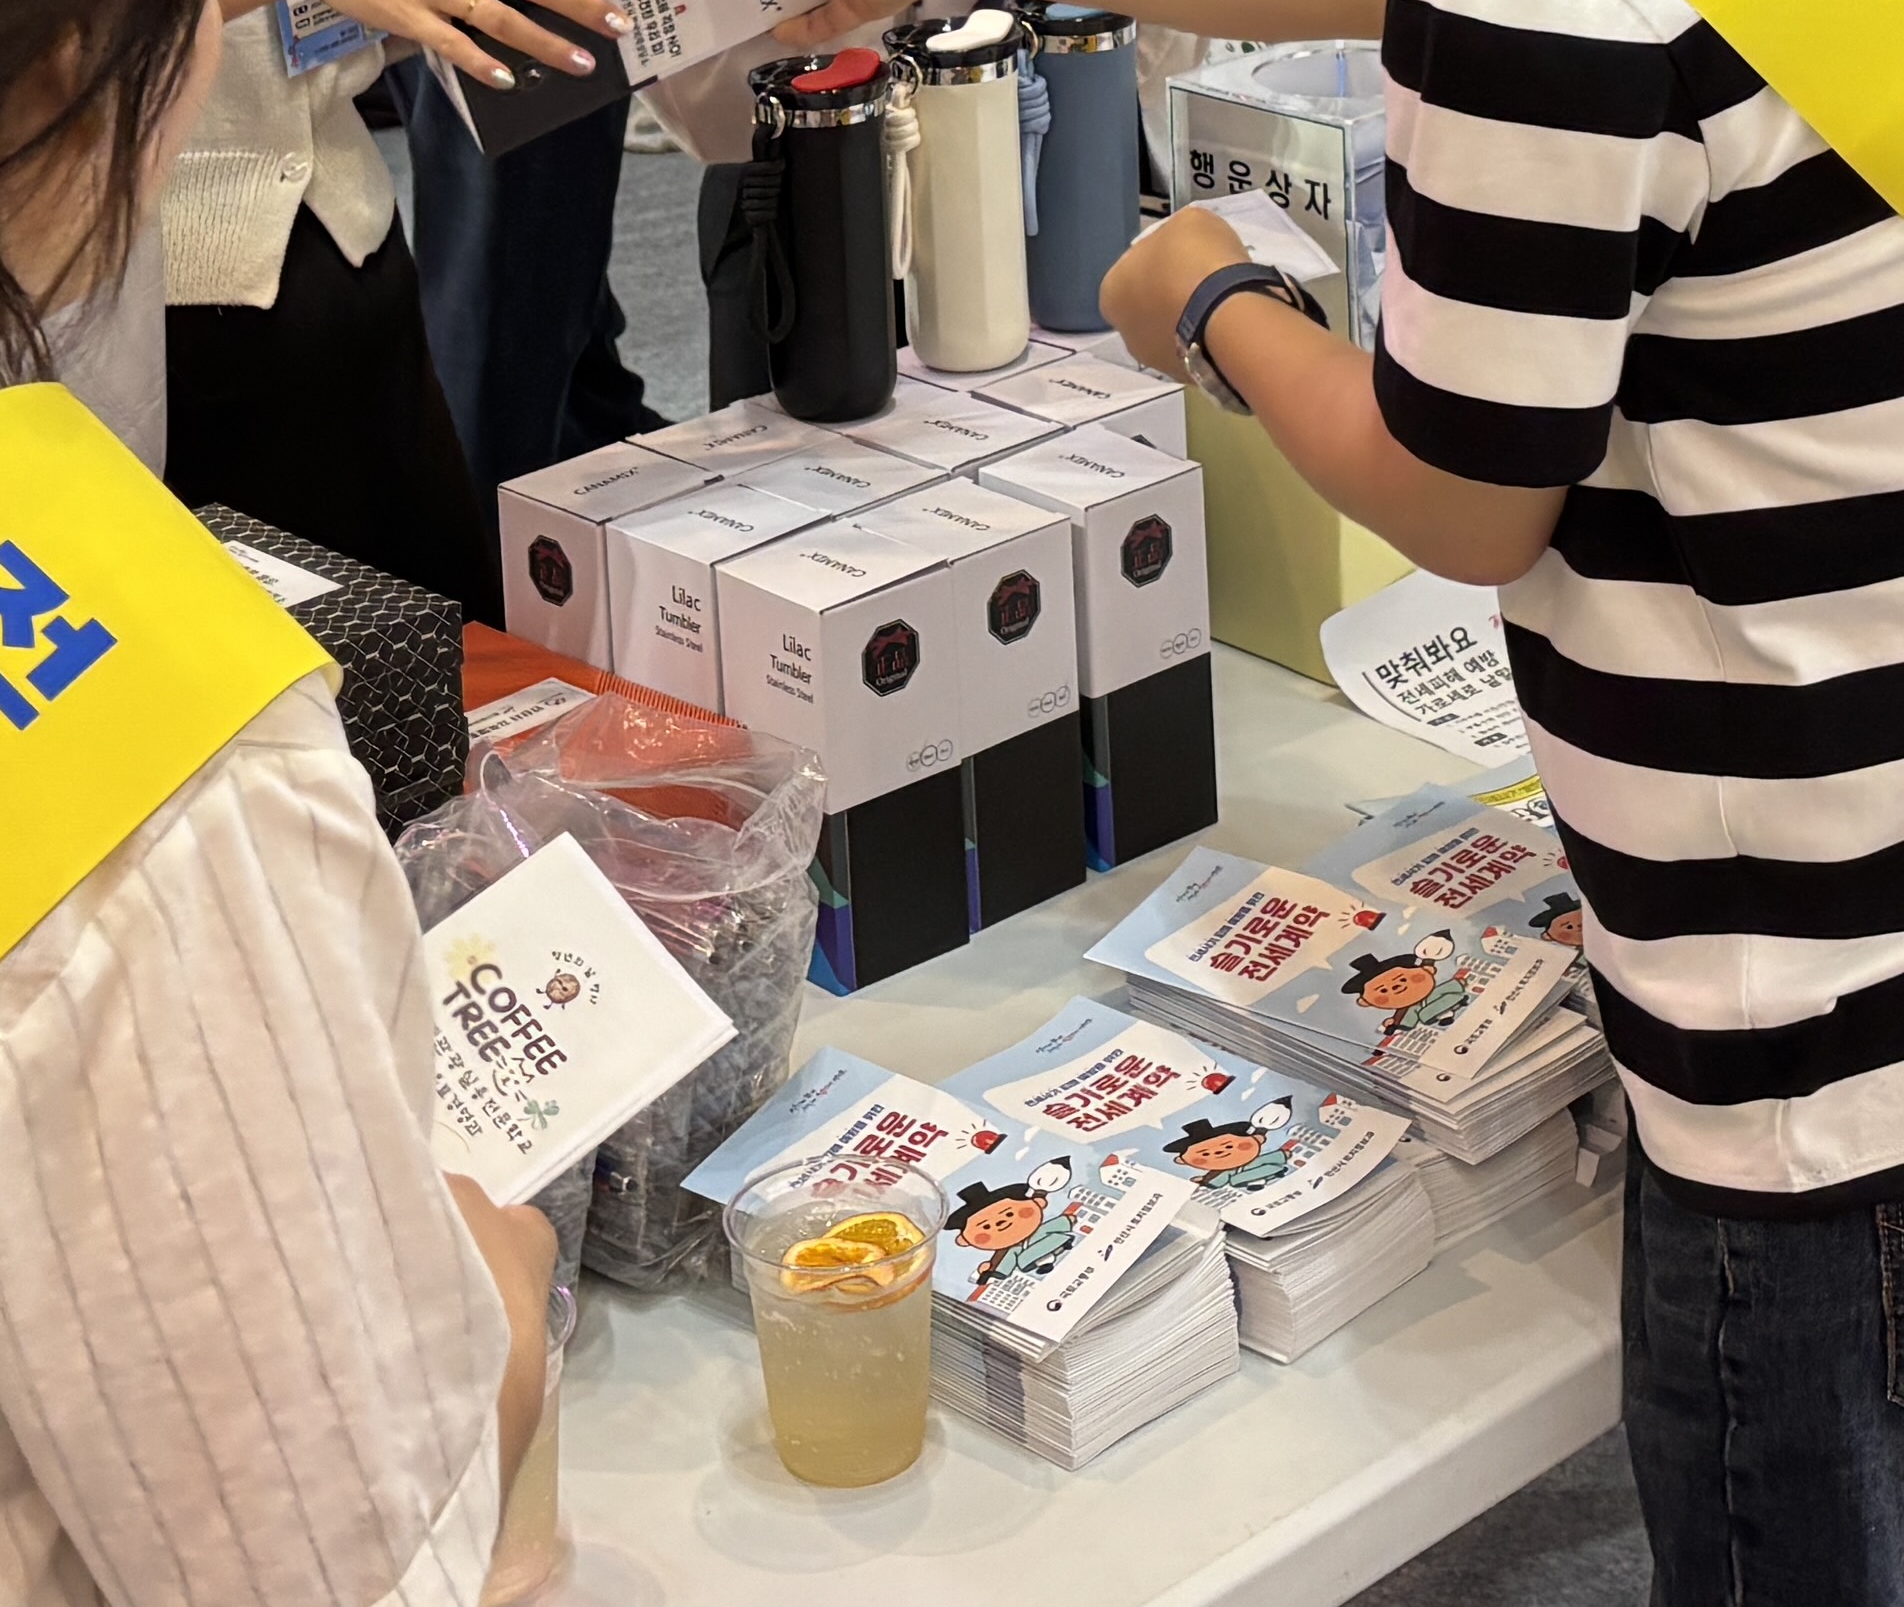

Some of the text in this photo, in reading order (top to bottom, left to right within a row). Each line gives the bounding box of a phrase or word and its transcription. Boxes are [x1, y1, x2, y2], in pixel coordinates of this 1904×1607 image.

[666, 35, 682, 58] NO!
[659, 606, 701, 634] Tumbler
[672, 585, 701, 612] Lilac
[770, 654, 812, 684] Tumbler
[783, 634, 812, 661] Lilac
[1375, 627, 1477, 690] 맞춰봐요
[1397, 650, 1499, 704] 전세피해 예방
[1415, 685, 1483, 715] 가로세로
[1410, 834, 1508, 897] 슬기로운
[1435, 845, 1536, 909] 전세계약
[1210, 897, 1296, 971] 슬기로운
[1238, 904, 1331, 981] 전세계약
[443, 981, 511, 1062] TREE
[470, 963, 567, 1075] COFFEE
[1042, 1056, 1146, 1119] 슬기로운
[1067, 1065, 1181, 1131] 전세계약
